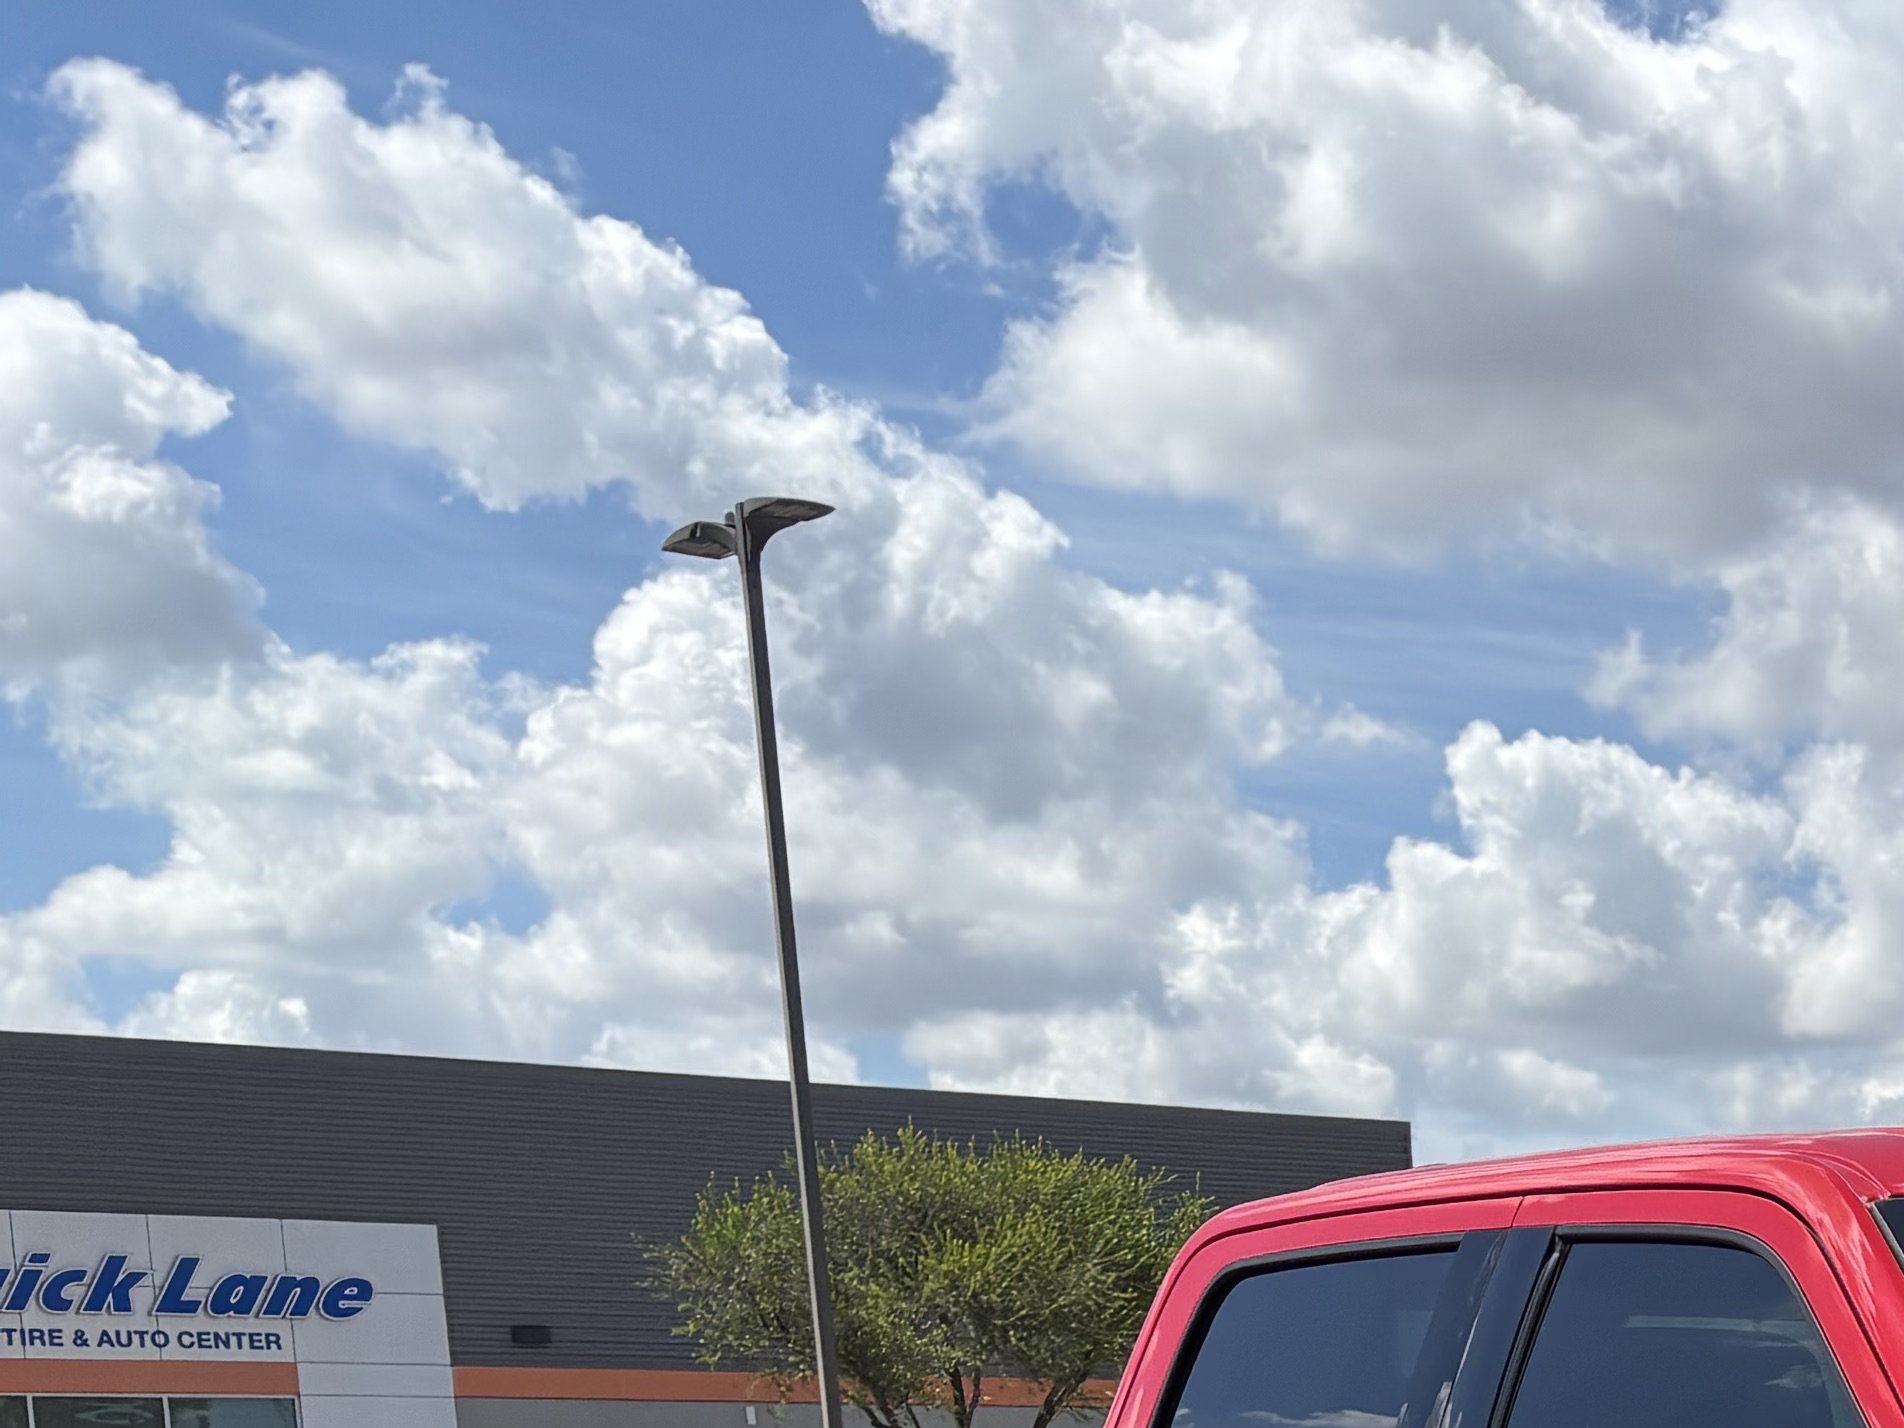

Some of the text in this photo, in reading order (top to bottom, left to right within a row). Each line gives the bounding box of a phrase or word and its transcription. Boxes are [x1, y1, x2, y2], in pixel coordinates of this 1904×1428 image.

[0, 1252, 374, 1321] ick Lane
[2, 1328, 282, 1350] TIRE & AUTO CENTER
